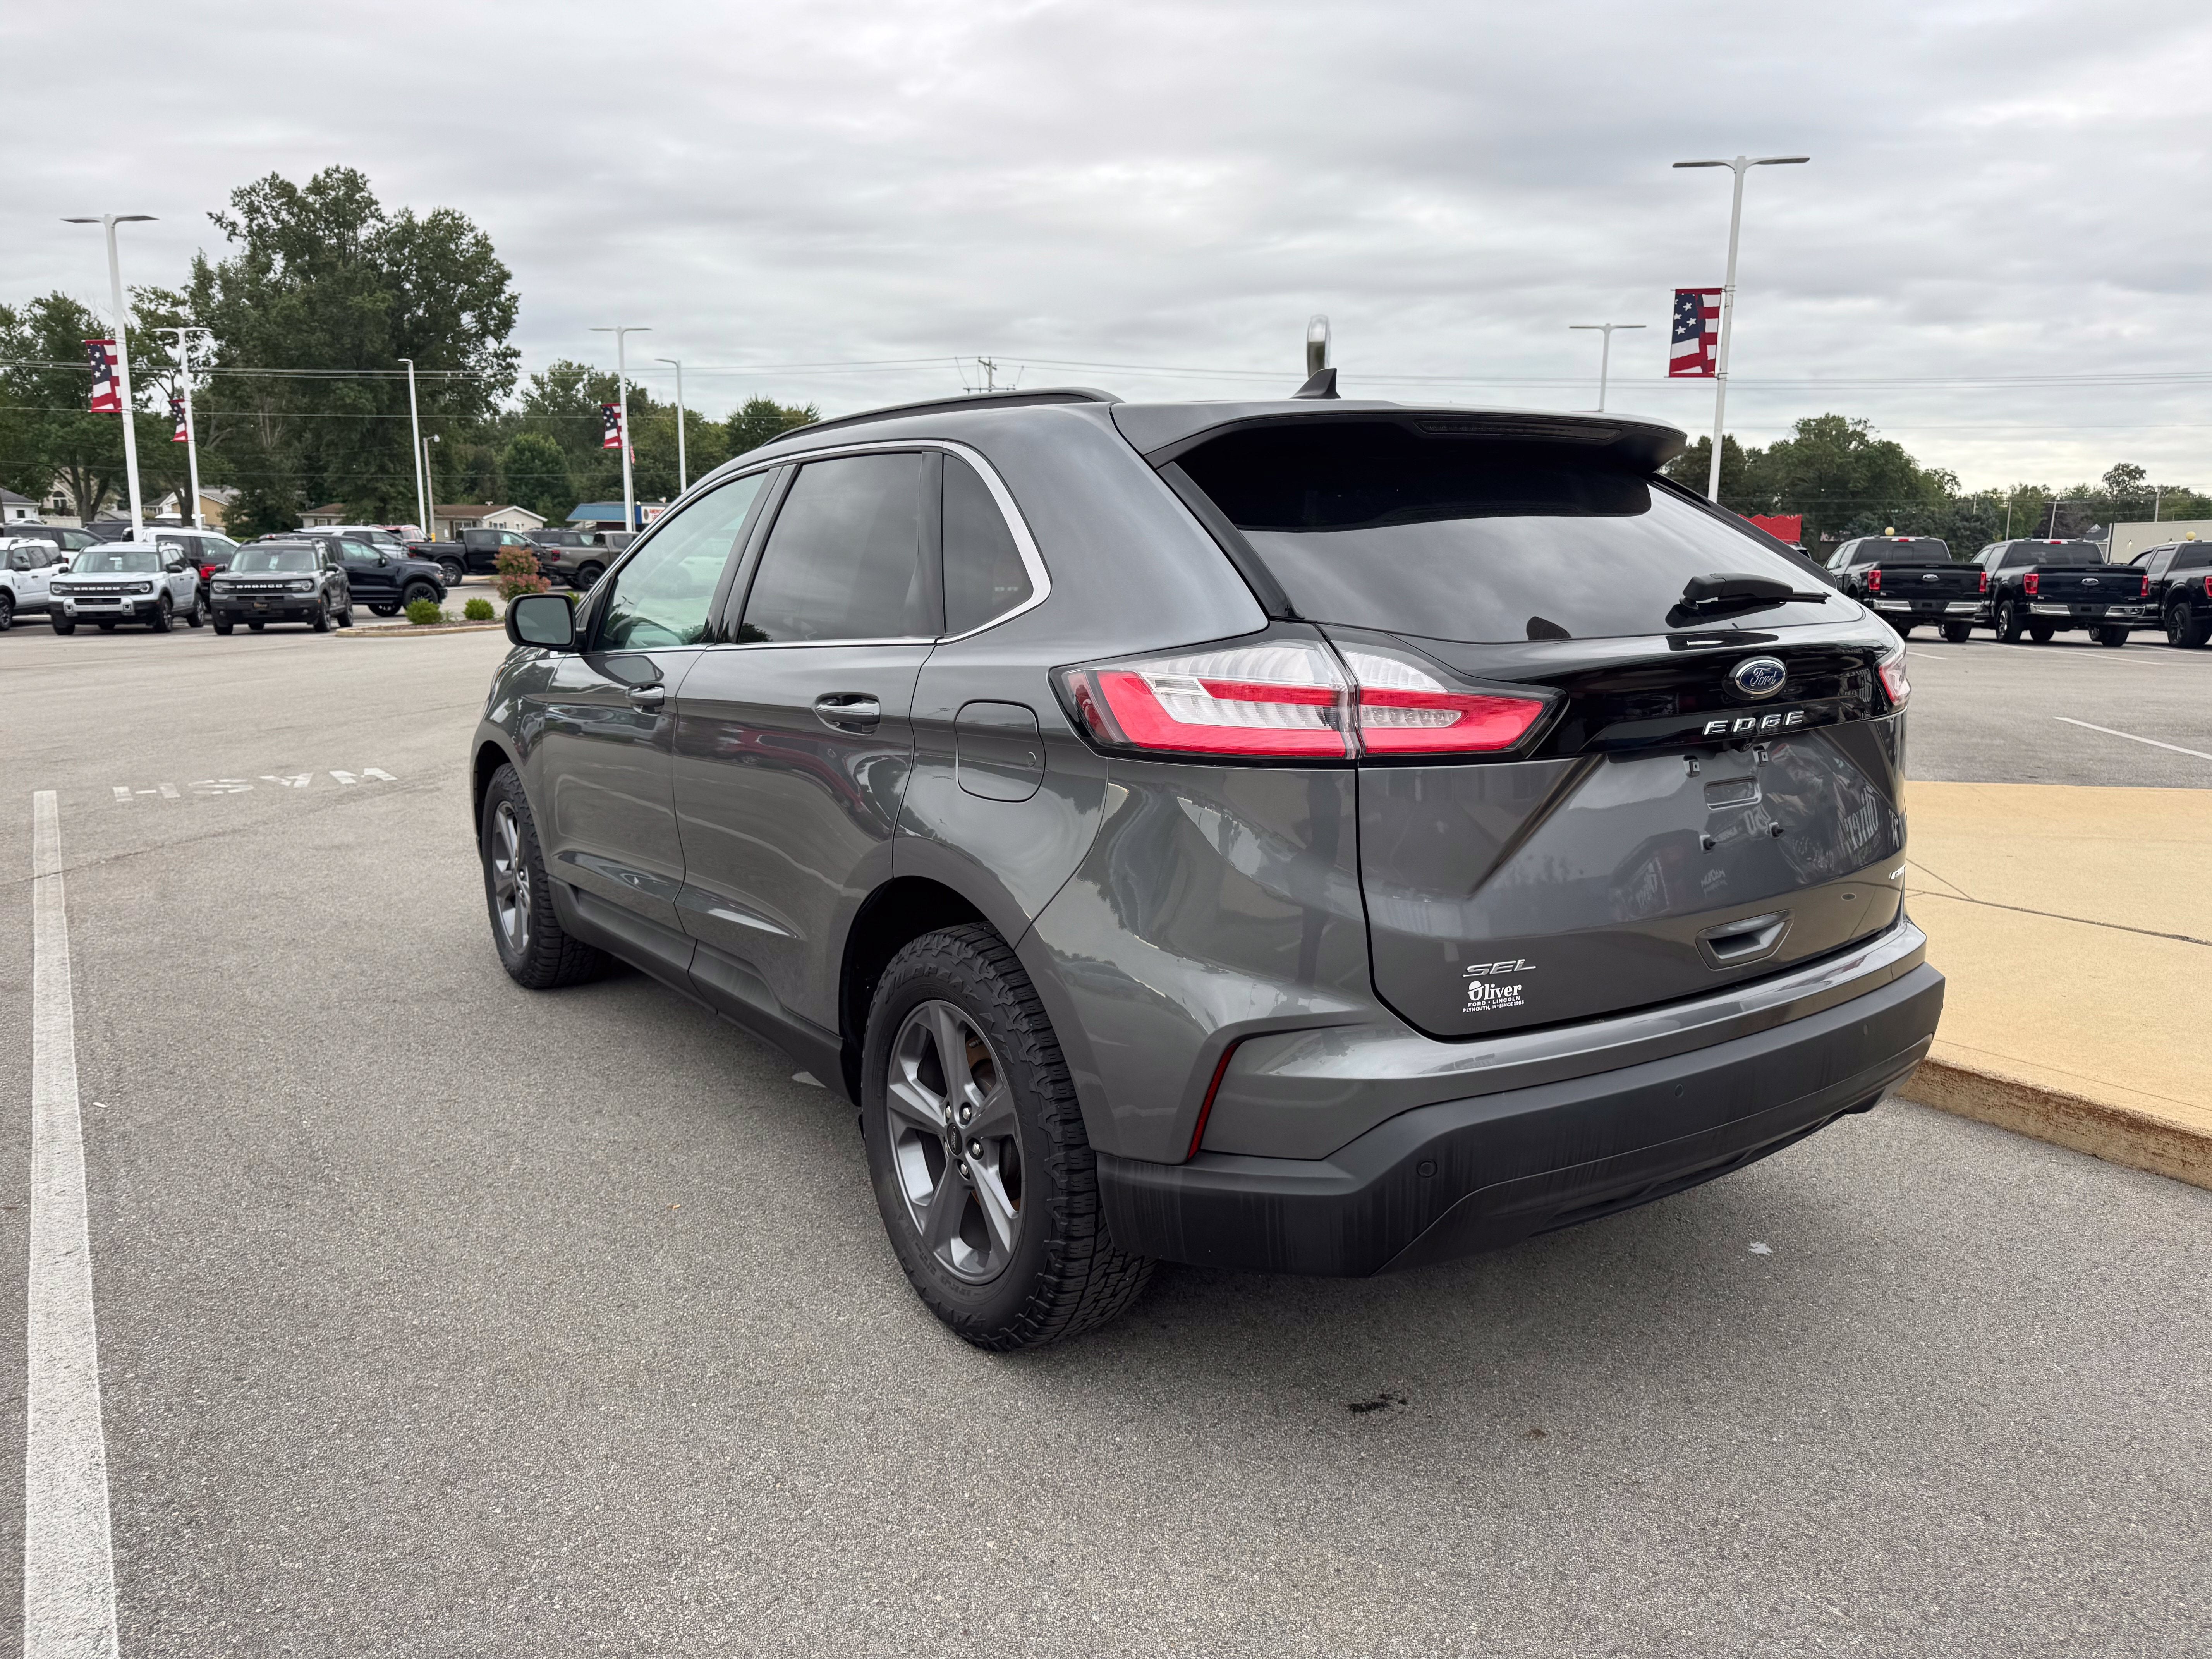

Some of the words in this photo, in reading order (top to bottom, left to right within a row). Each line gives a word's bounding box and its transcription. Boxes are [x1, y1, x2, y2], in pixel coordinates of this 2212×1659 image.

[1750, 667, 1778, 687] Ford
[1702, 710, 1804, 735] EDGE
[1462, 959, 1536, 977] SEL
[1467, 981, 1522, 1001] Oliver
[1492, 995, 1520, 1005] LINCOLN
